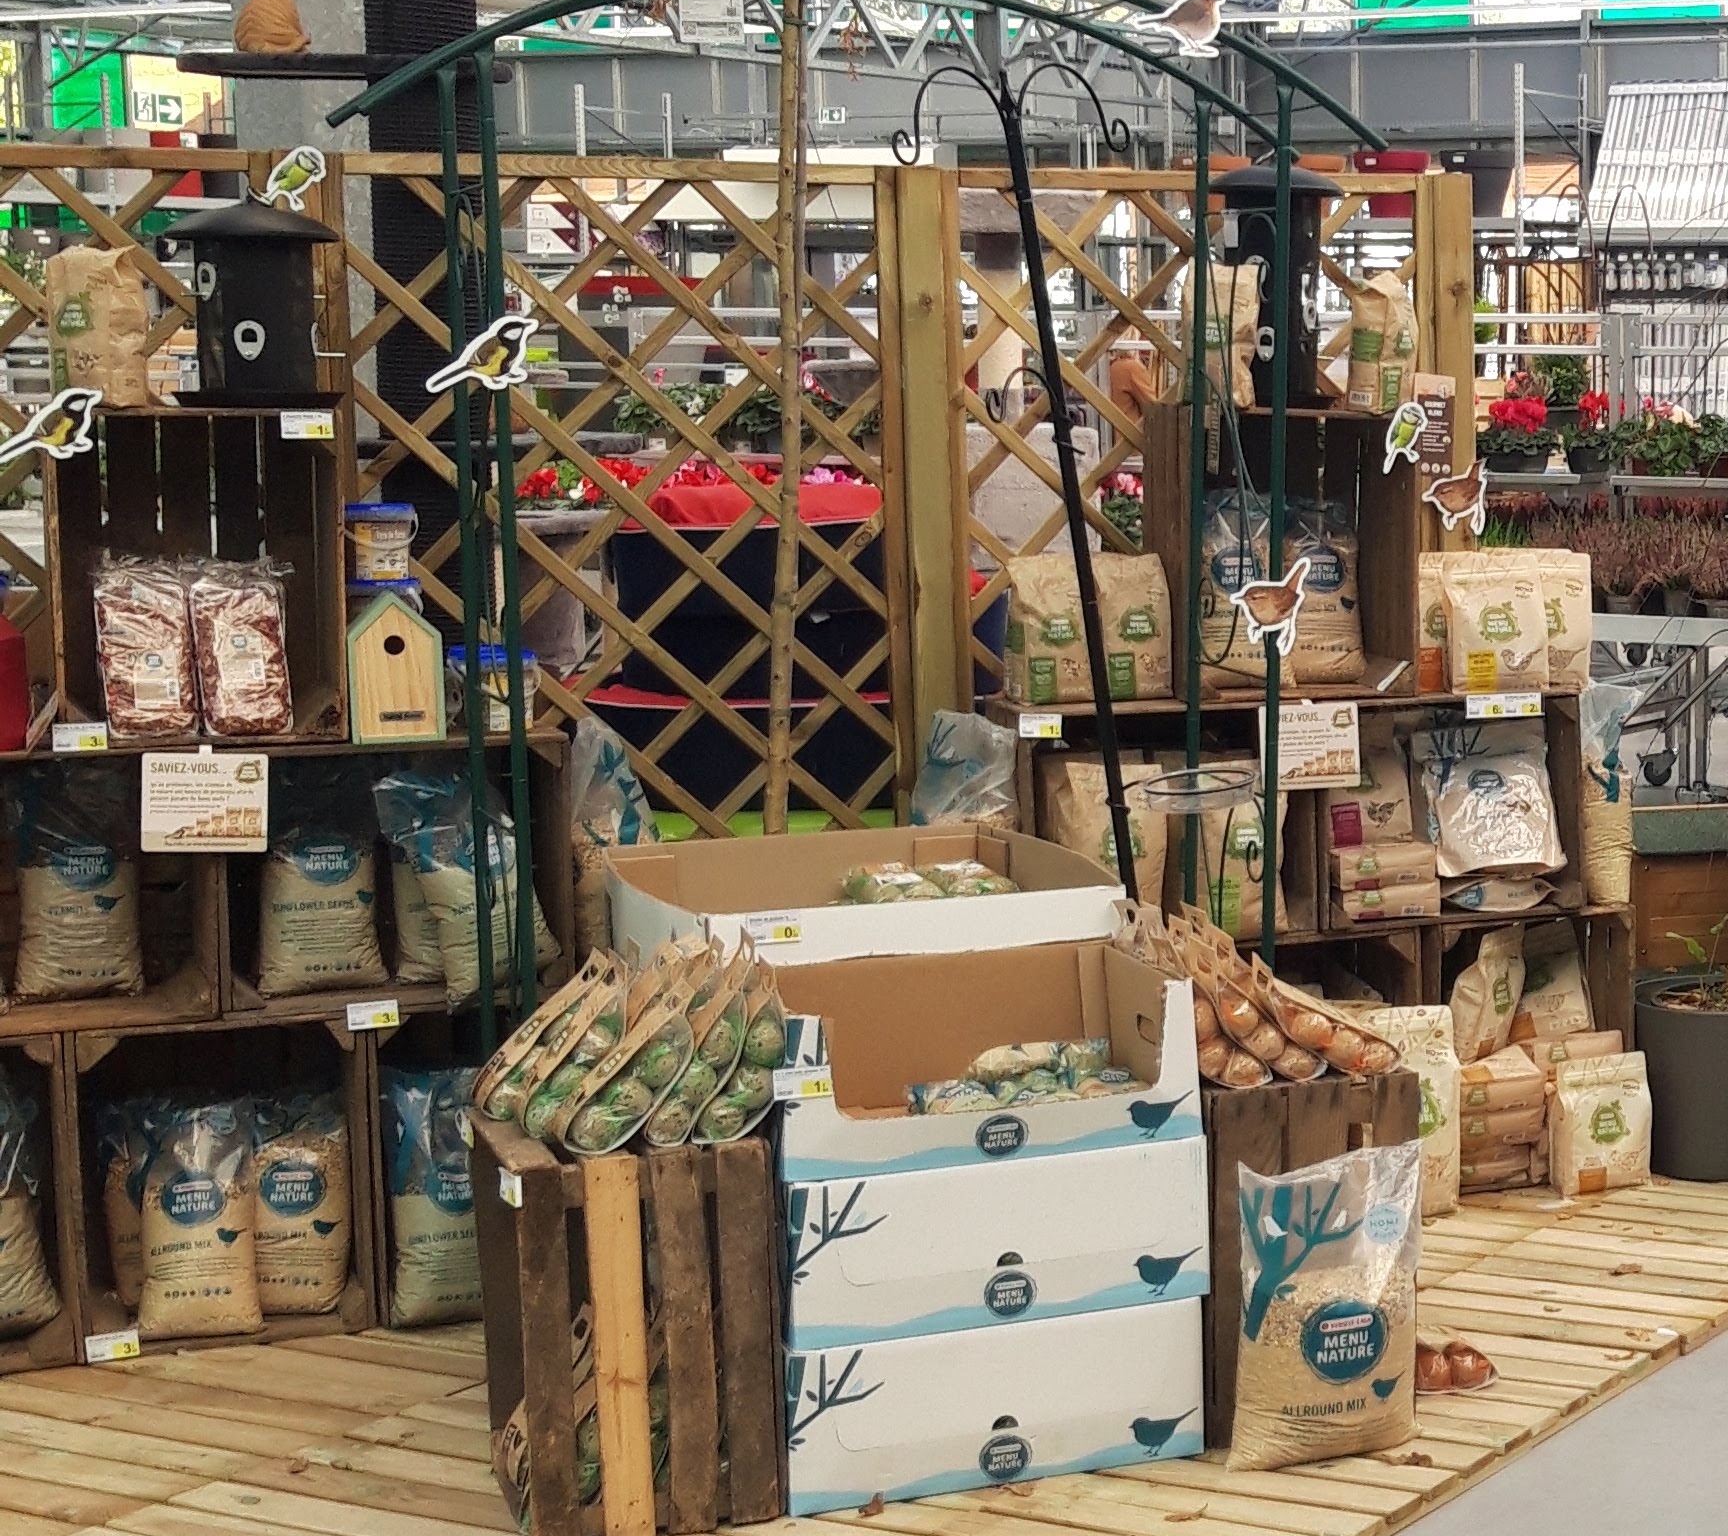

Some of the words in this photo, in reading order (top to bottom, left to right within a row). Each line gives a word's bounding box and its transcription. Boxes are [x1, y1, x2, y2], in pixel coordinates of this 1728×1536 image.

[276, 1182, 309, 1193] MENU
[175, 1191, 210, 1205] MENU
[269, 1191, 314, 1203] NATURE
[171, 1200, 216, 1215] NATURE
[997, 1288, 1023, 1299] MENU
[992, 1295, 1027, 1308] NATURE
[1324, 1330, 1369, 1349] MENU
[1316, 1342, 1375, 1364] NATURE
[1282, 1400, 1343, 1417] ALLROUND
[1346, 1396, 1367, 1412] MIX
[992, 1452, 1019, 1463] MENU
[988, 1459, 1023, 1471] NATURE
